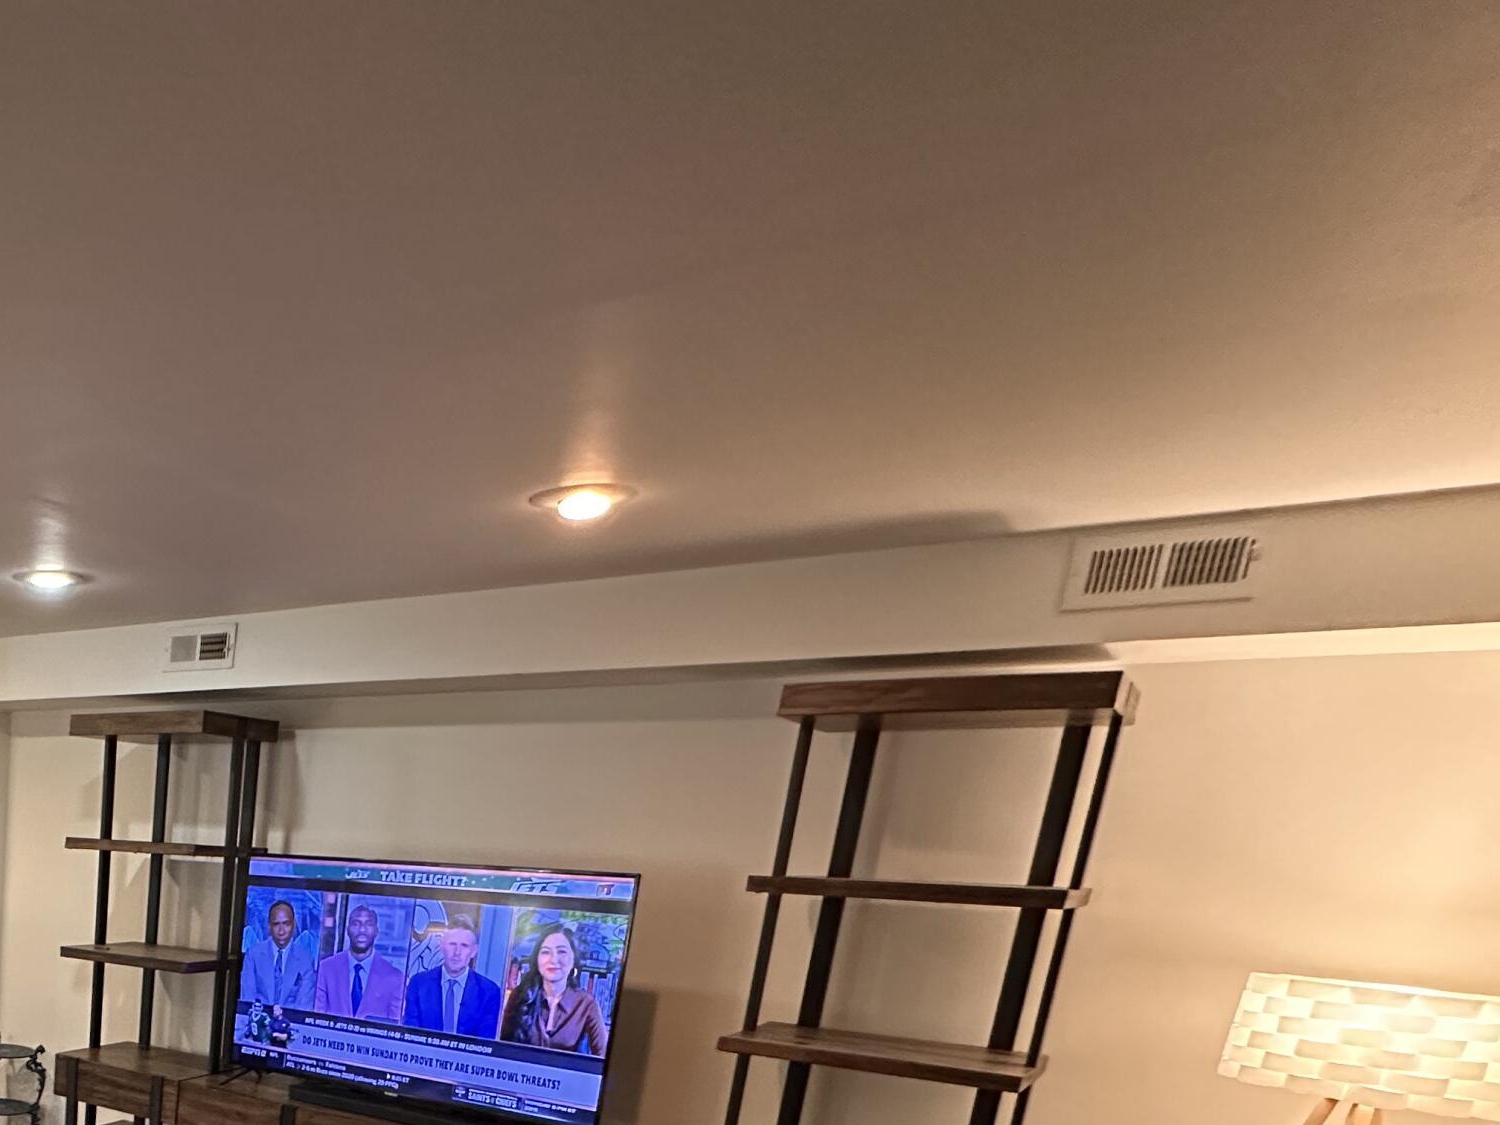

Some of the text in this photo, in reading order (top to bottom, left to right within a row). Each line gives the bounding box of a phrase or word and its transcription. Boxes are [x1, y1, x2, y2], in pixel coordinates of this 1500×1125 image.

[380, 870, 467, 886] TAKE FLIGHT?
[510, 878, 564, 893] JETS
[335, 1022, 347, 1030] JETS
[302, 1035, 561, 1091] DO JETS NEED TO WIN SUNDAY TO PROVE THEY ARE SUPER BOWL THREATS?
